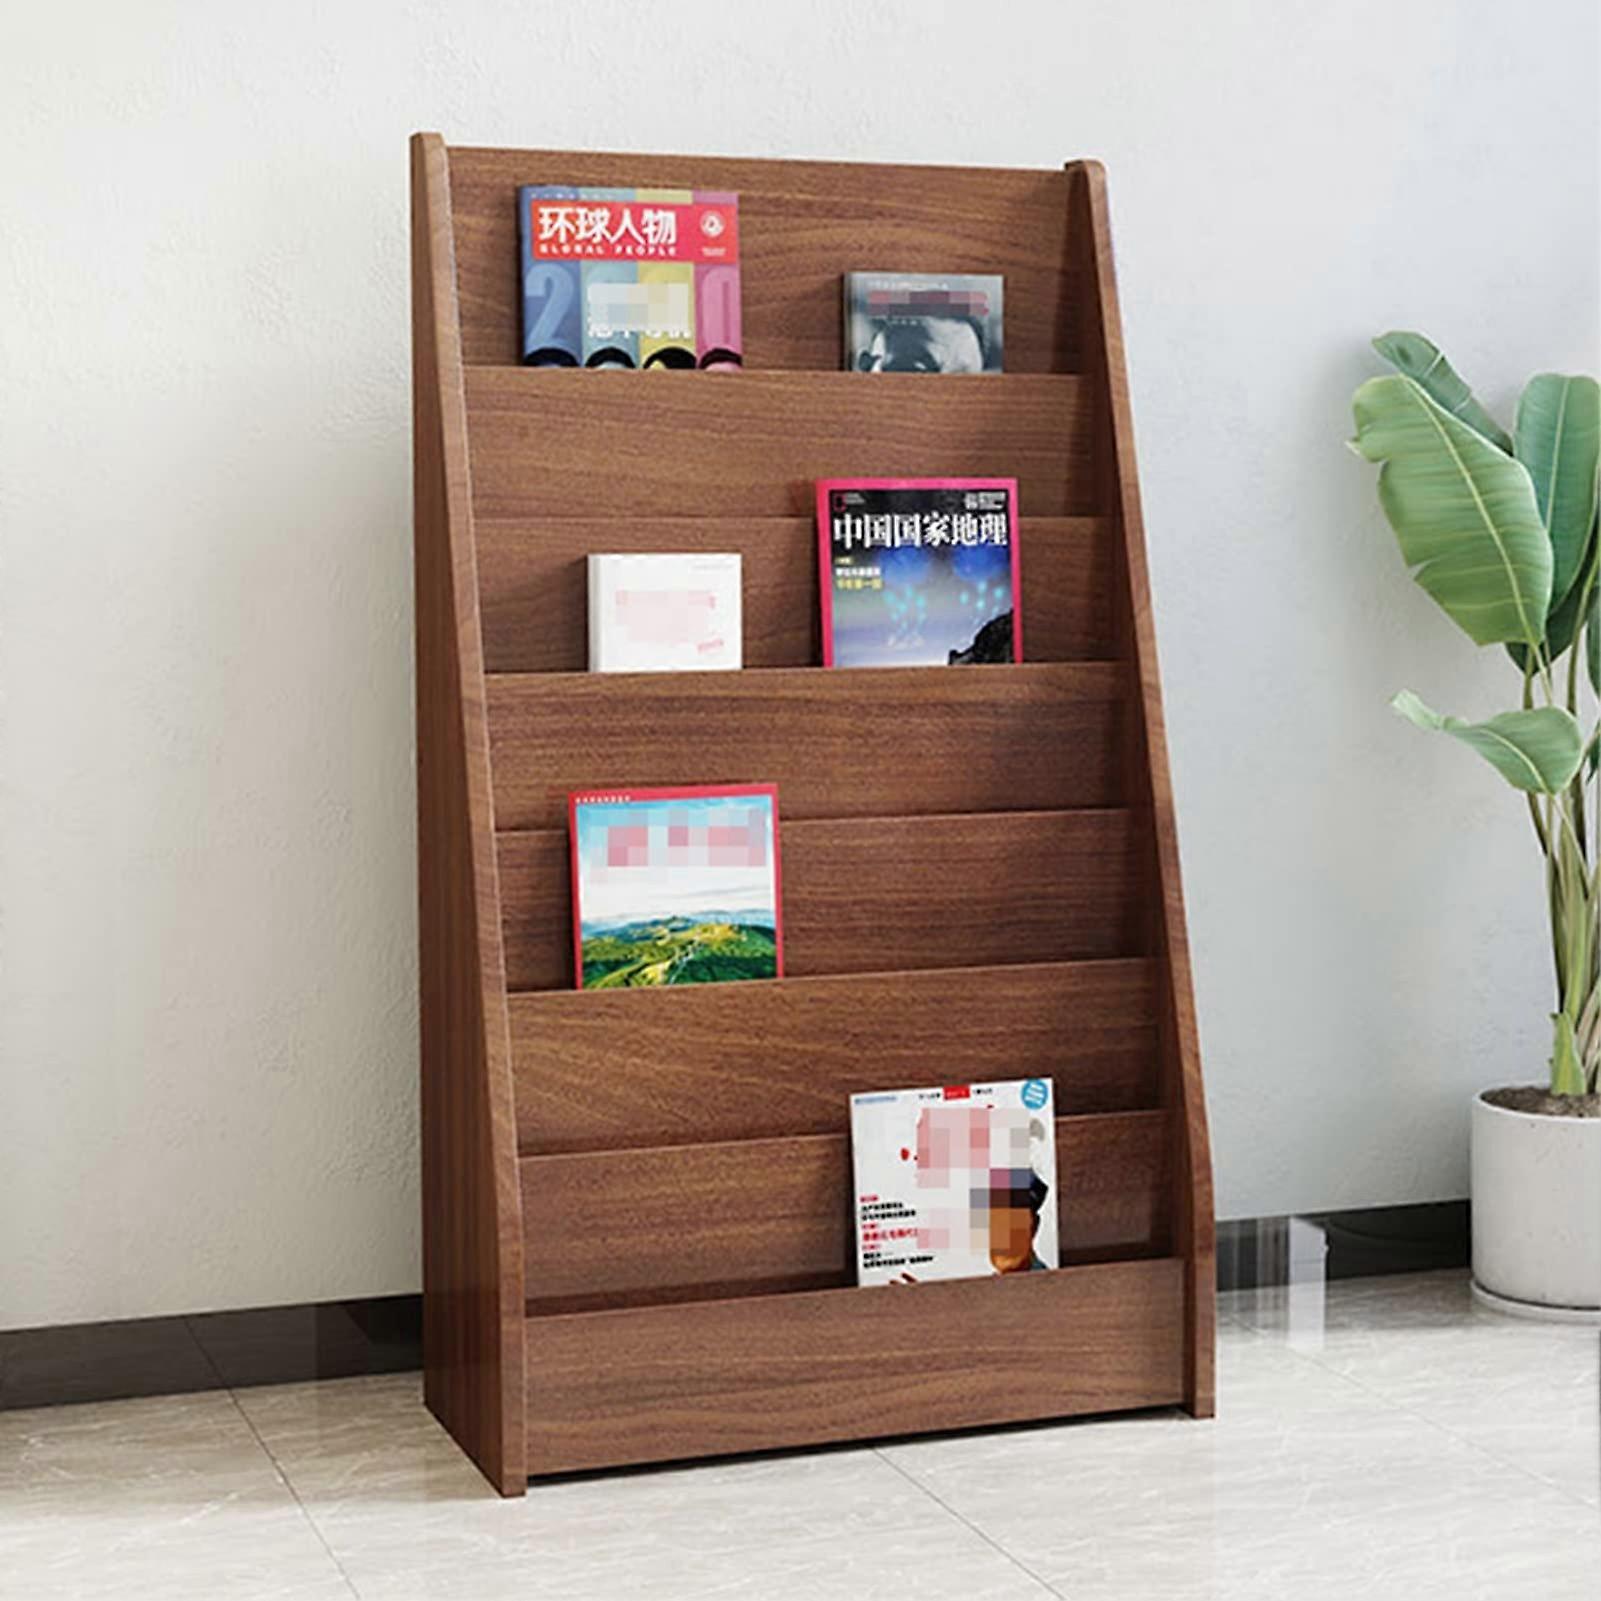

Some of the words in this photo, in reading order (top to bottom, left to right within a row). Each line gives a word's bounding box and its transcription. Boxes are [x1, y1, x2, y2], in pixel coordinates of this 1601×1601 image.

[538, 207, 677, 245] 环球人物
[539, 244, 605, 255] GLOBAL
[614, 245, 678, 256] PEOPLE
[833, 511, 1008, 549] 中国国家地理
